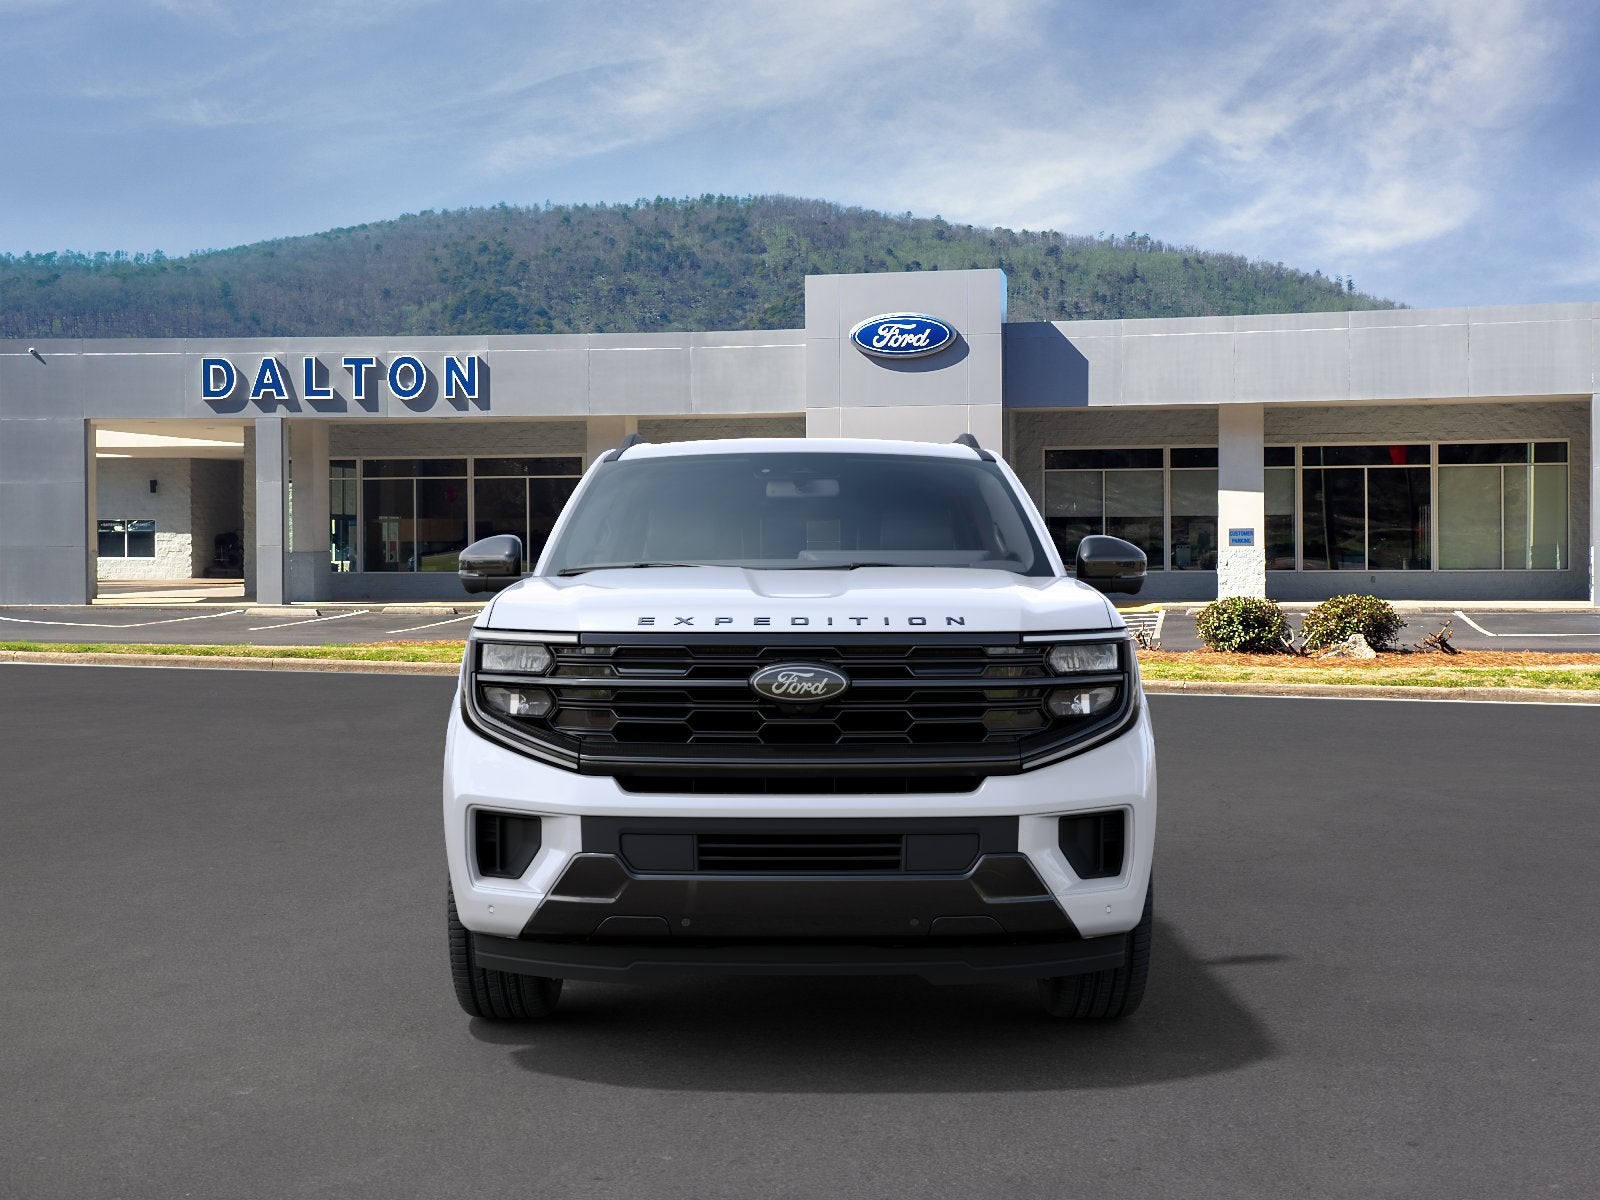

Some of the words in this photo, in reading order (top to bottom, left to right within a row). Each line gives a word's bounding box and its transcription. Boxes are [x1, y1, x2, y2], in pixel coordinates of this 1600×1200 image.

[873, 323, 931, 347] Ford
[201, 355, 478, 400] DALTON
[637, 616, 966, 626] EXPEDITION
[771, 671, 829, 694] Ford
